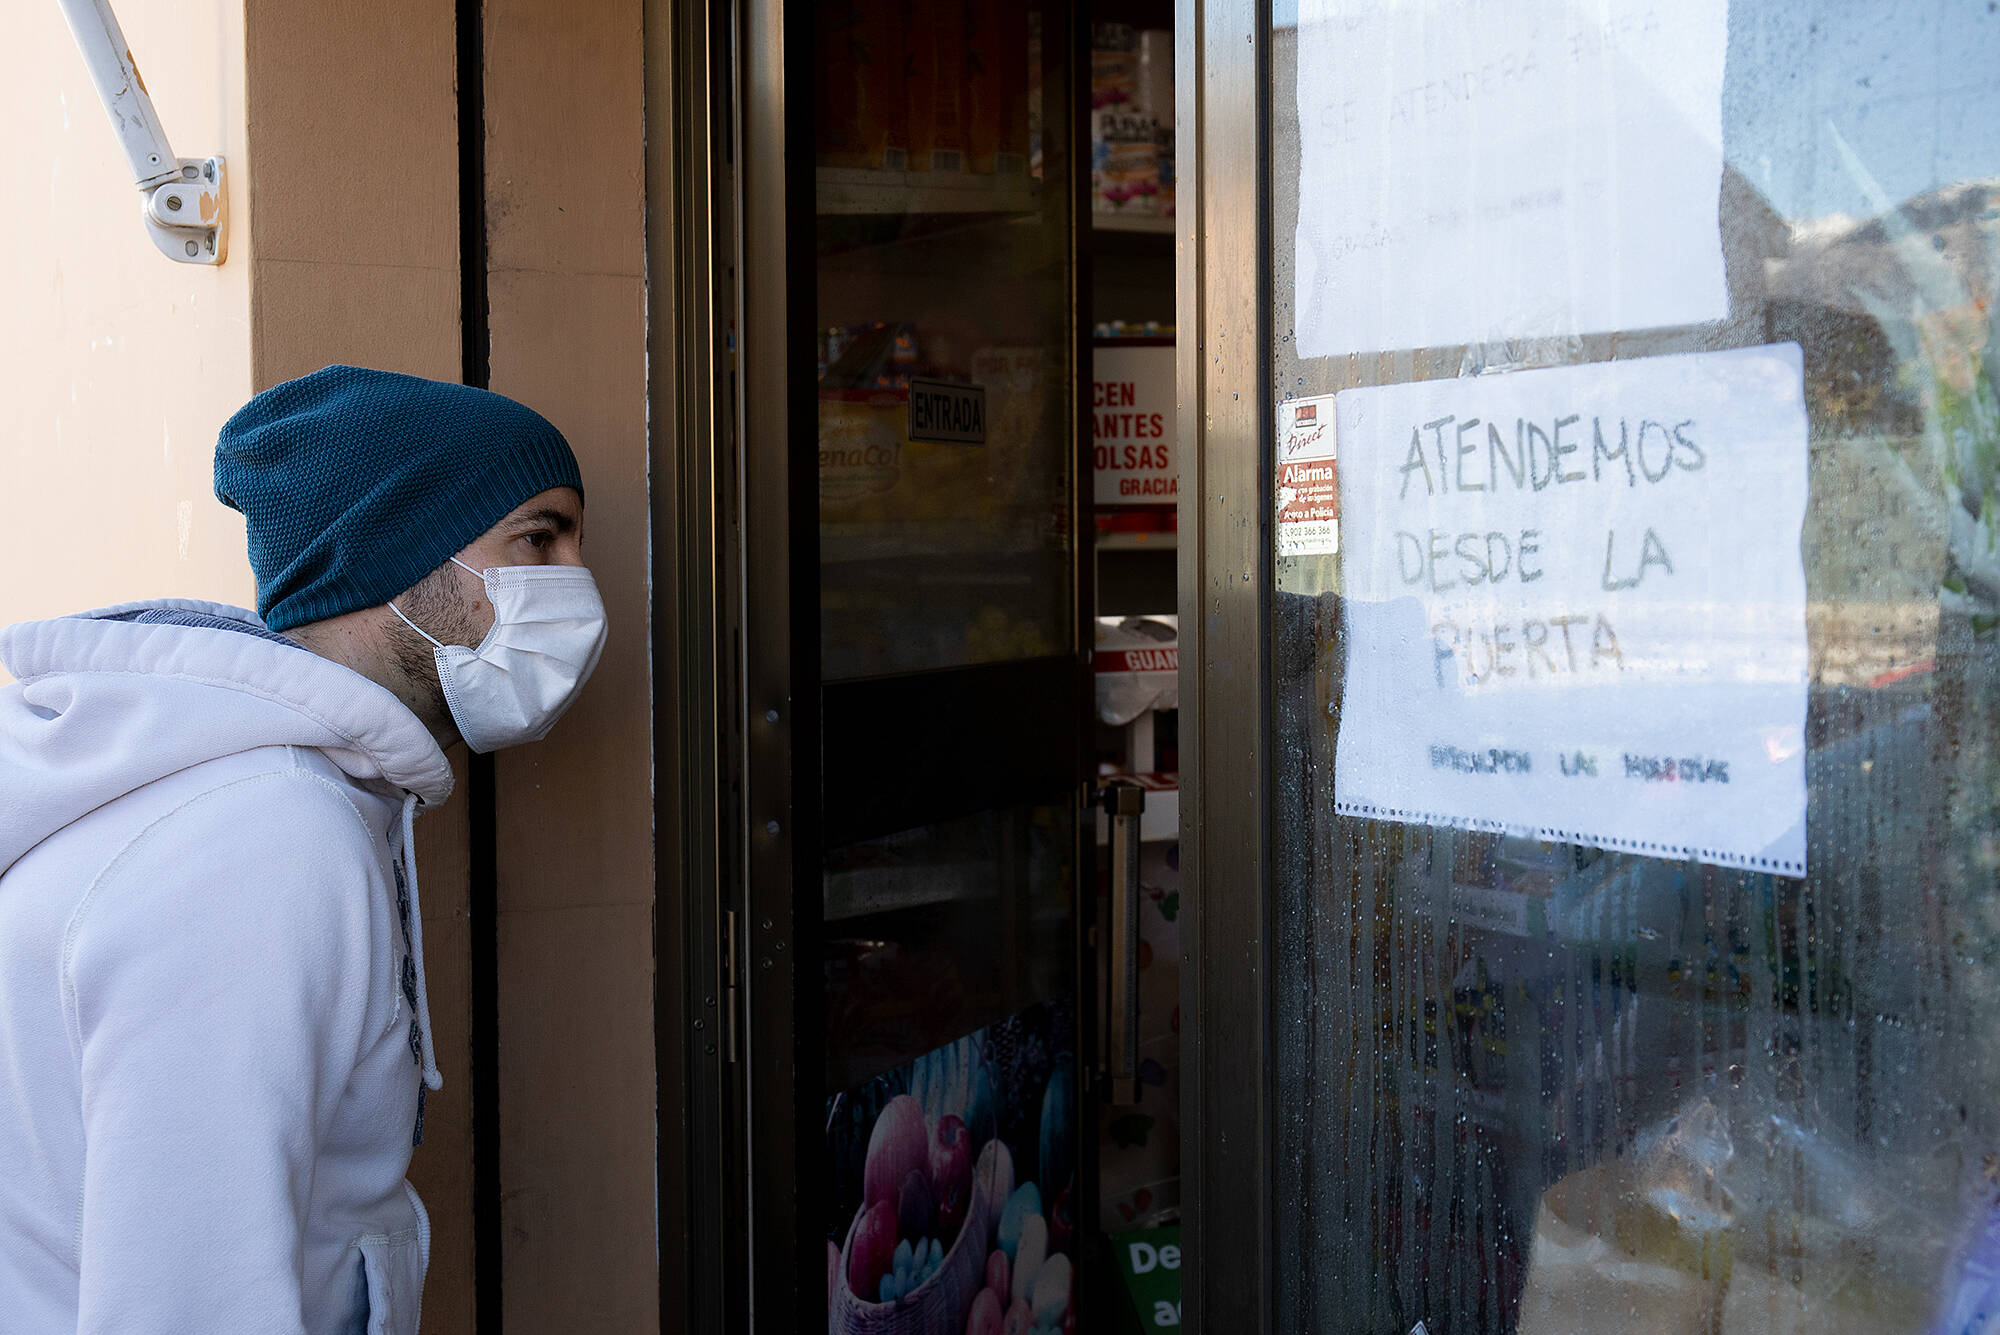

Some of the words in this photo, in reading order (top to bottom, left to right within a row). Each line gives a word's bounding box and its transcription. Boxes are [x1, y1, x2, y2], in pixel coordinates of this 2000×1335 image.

[915, 391, 982, 434] ENTRADA
[1094, 381, 1135, 407] CEN
[1286, 423, 1328, 456] Direct
[1399, 413, 1706, 500] ATENDEMOS
[1283, 463, 1333, 484] Alarma
[1393, 527, 1544, 593] DESDE
[1602, 526, 1674, 592] LA
[1431, 612, 1626, 690] PUERTA
[1153, 1299, 1182, 1327] a
